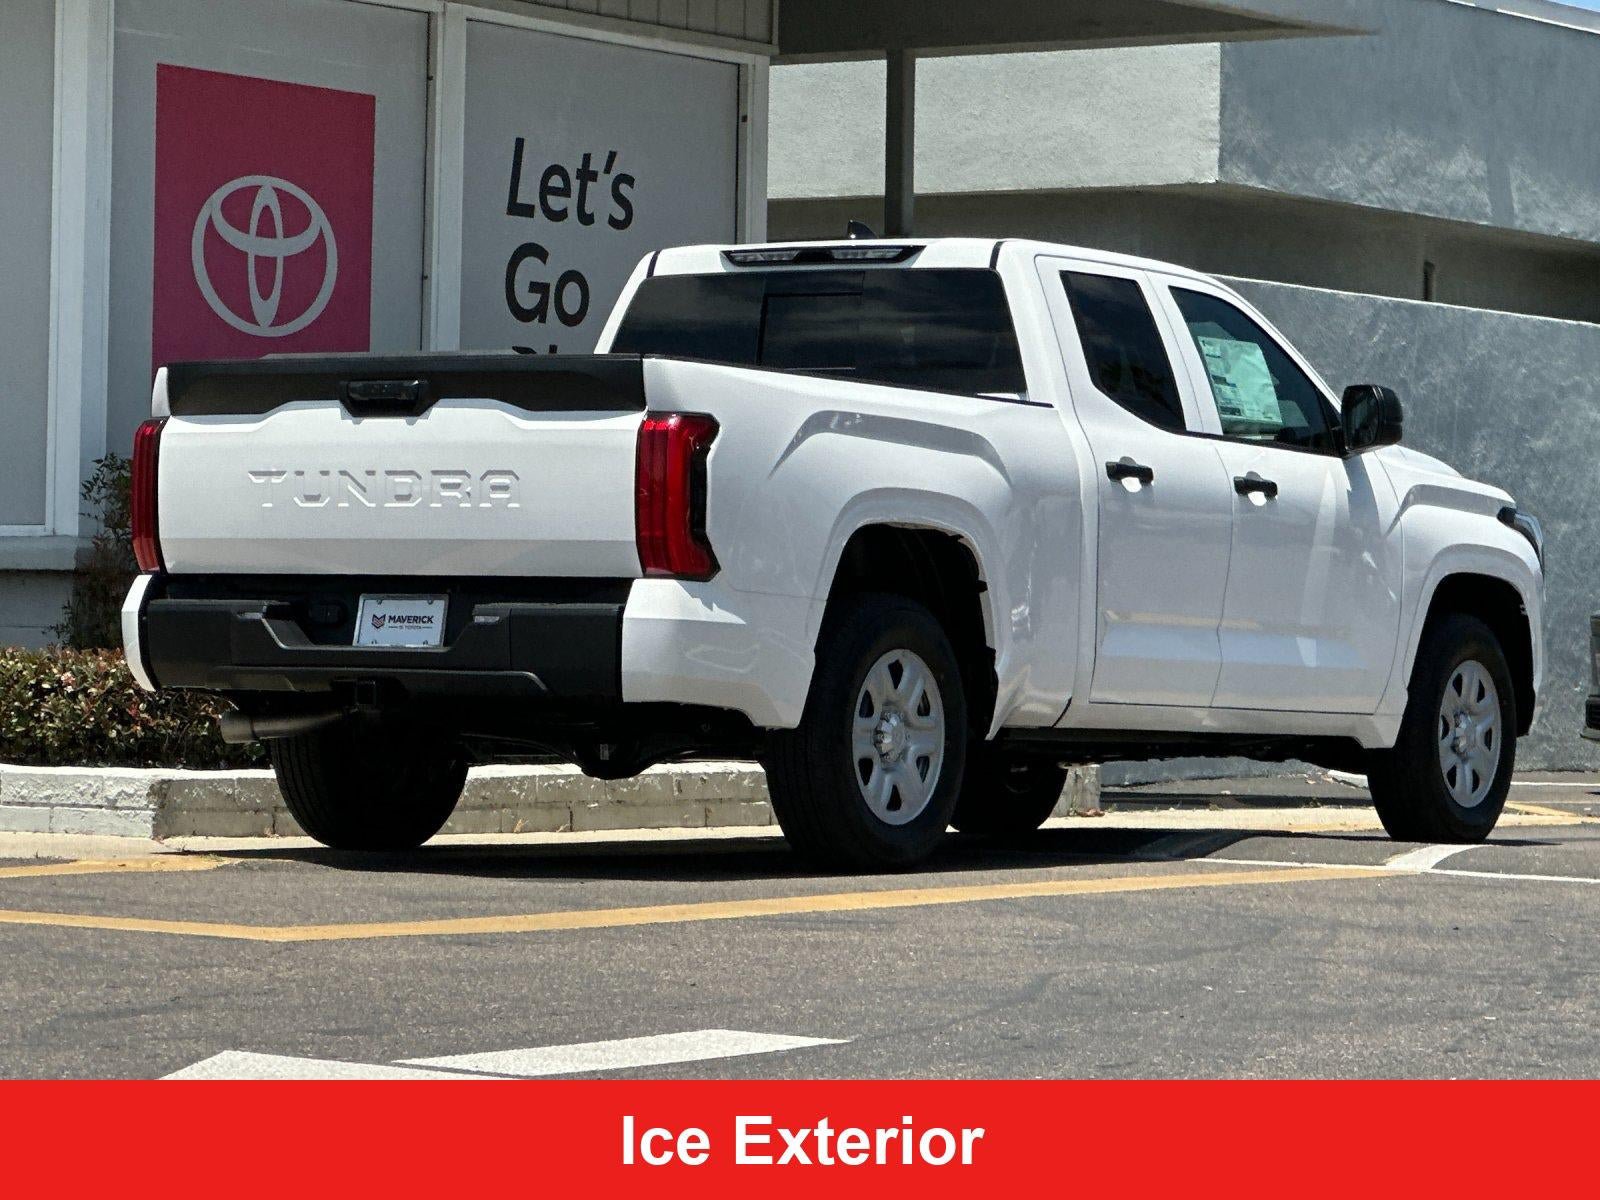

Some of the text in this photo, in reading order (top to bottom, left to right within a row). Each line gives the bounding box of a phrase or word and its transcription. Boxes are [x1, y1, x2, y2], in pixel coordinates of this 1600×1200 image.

[506, 137, 636, 231] Let's
[505, 242, 590, 328] Go
[248, 469, 520, 508] TUNDRA
[388, 615, 434, 624] MAVERICK
